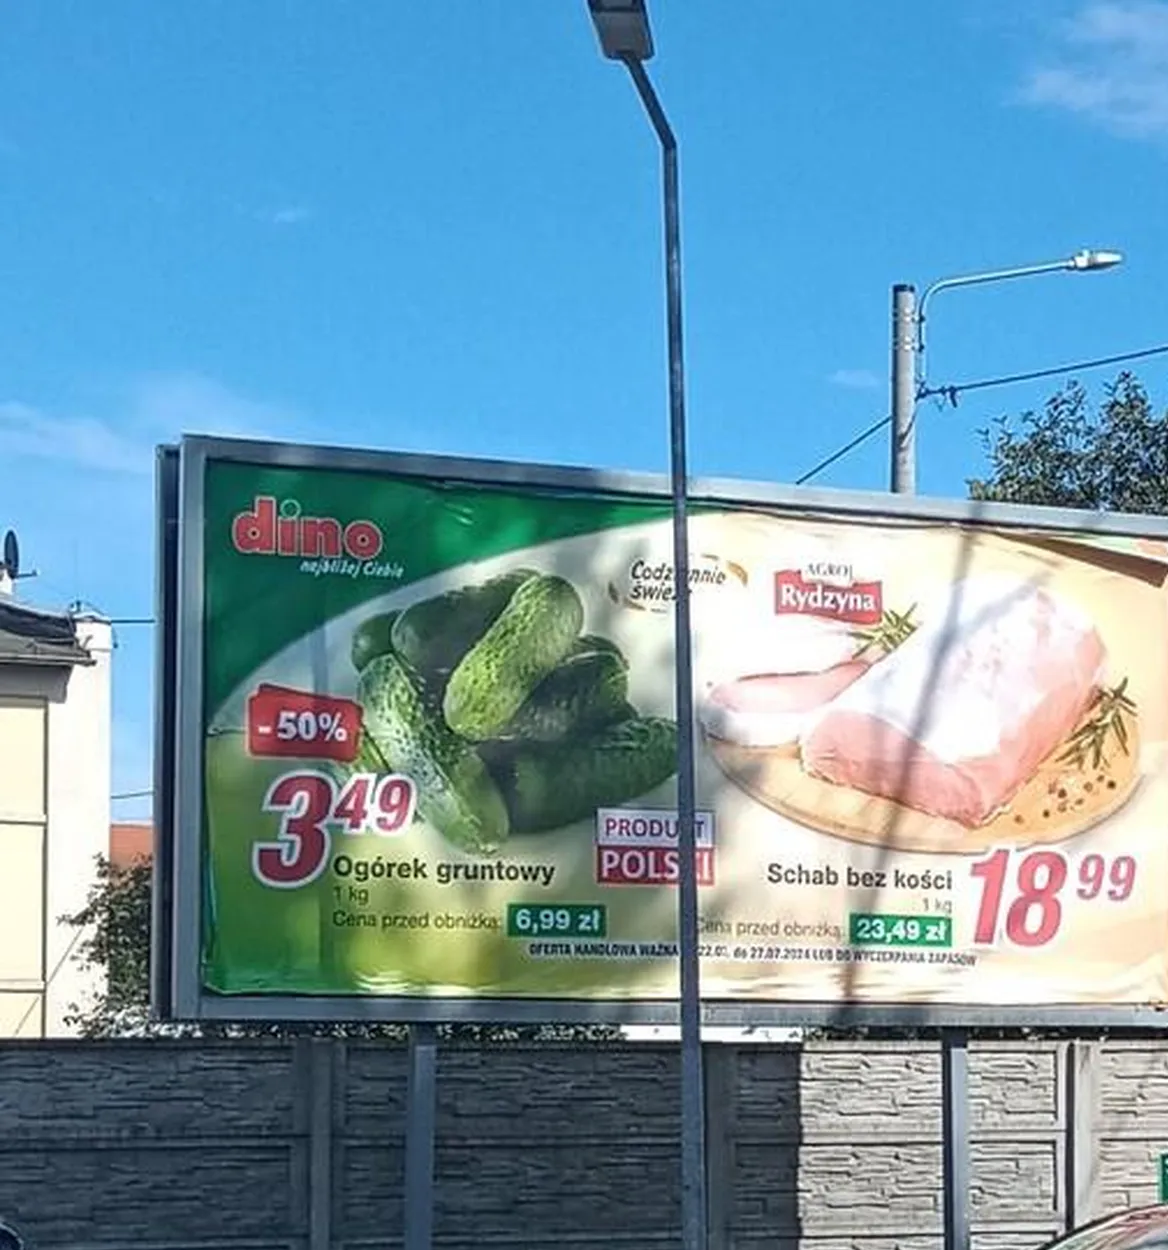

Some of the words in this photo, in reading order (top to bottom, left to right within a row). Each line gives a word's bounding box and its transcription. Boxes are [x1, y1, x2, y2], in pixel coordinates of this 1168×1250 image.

[232, 496, 383, 560] dino
[630, 559, 727, 585] Codznnie
[781, 583, 877, 614] Rydzyna
[605, 818, 705, 838] PRODUT
[333, 856, 428, 881] Ogórek
[436, 861, 555, 886] gruntowy
[602, 850, 710, 880] POLSI
[767, 863, 839, 886] Schab
[846, 867, 887, 887] bez
[893, 869, 952, 890] kości
[348, 886, 369, 905] kg
[934, 897, 952, 914] kg
[332, 910, 377, 927] Cena
[381, 912, 429, 931] przed
[515, 908, 571, 935] 6,99
[578, 909, 600, 931] zł
[736, 918, 779, 938] przed
[856, 918, 921, 943] 23,49
[925, 920, 947, 940] zł
[529, 943, 571, 955] OFERTA
[574, 943, 637, 956] HANDLOWA
